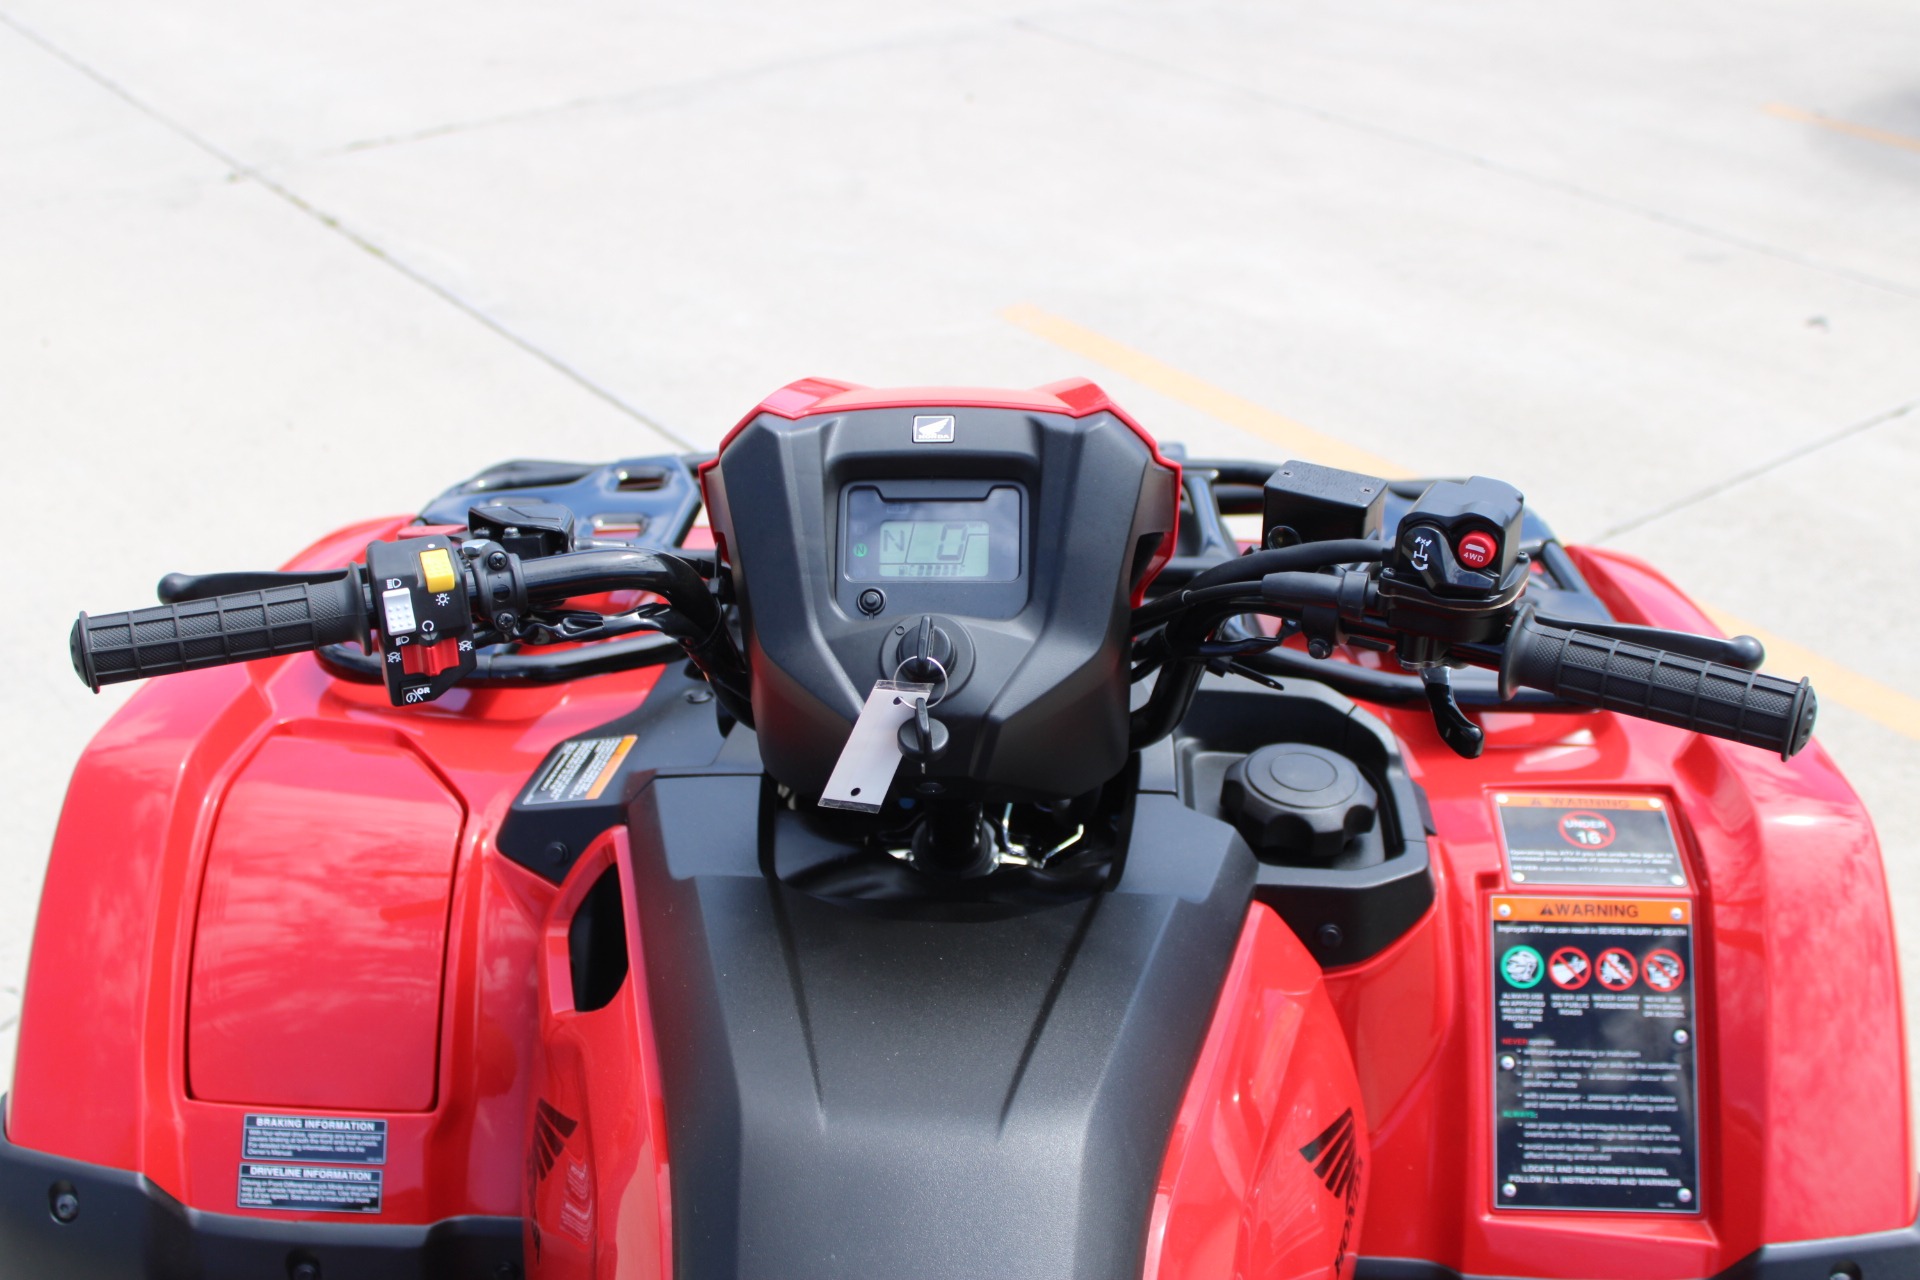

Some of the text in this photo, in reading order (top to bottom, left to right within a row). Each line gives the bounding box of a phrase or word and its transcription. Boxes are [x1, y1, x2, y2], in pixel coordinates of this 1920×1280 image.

[883, 523, 968, 560] N 0
[856, 545, 865, 554] N
[1463, 552, 1484, 562] 4WD
[417, 687, 430, 695] OR
[1551, 798, 1630, 809] WARNING
[1564, 819, 1607, 829] UNDER
[1577, 830, 1602, 844] 16
[1555, 903, 1639, 917] WARNING
[1501, 1038, 1528, 1046] NEVER
[256, 1117, 375, 1131] BRAKING INFORMATION
[250, 1166, 371, 1180] DRIVELINE INFORMATION
[1521, 1164, 1554, 1172] LOCATE
[1556, 1165, 1574, 1173] AND
[1574, 1165, 1597, 1174] READ
[1597, 1166, 1634, 1175] OWNER'S
[1508, 1175, 1543, 1183] FOLLOW
[1543, 1175, 1560, 1183] ALL
[1560, 1176, 1619, 1185] INSTRUCTIONS
[1619, 1177, 1637, 1185] AND
